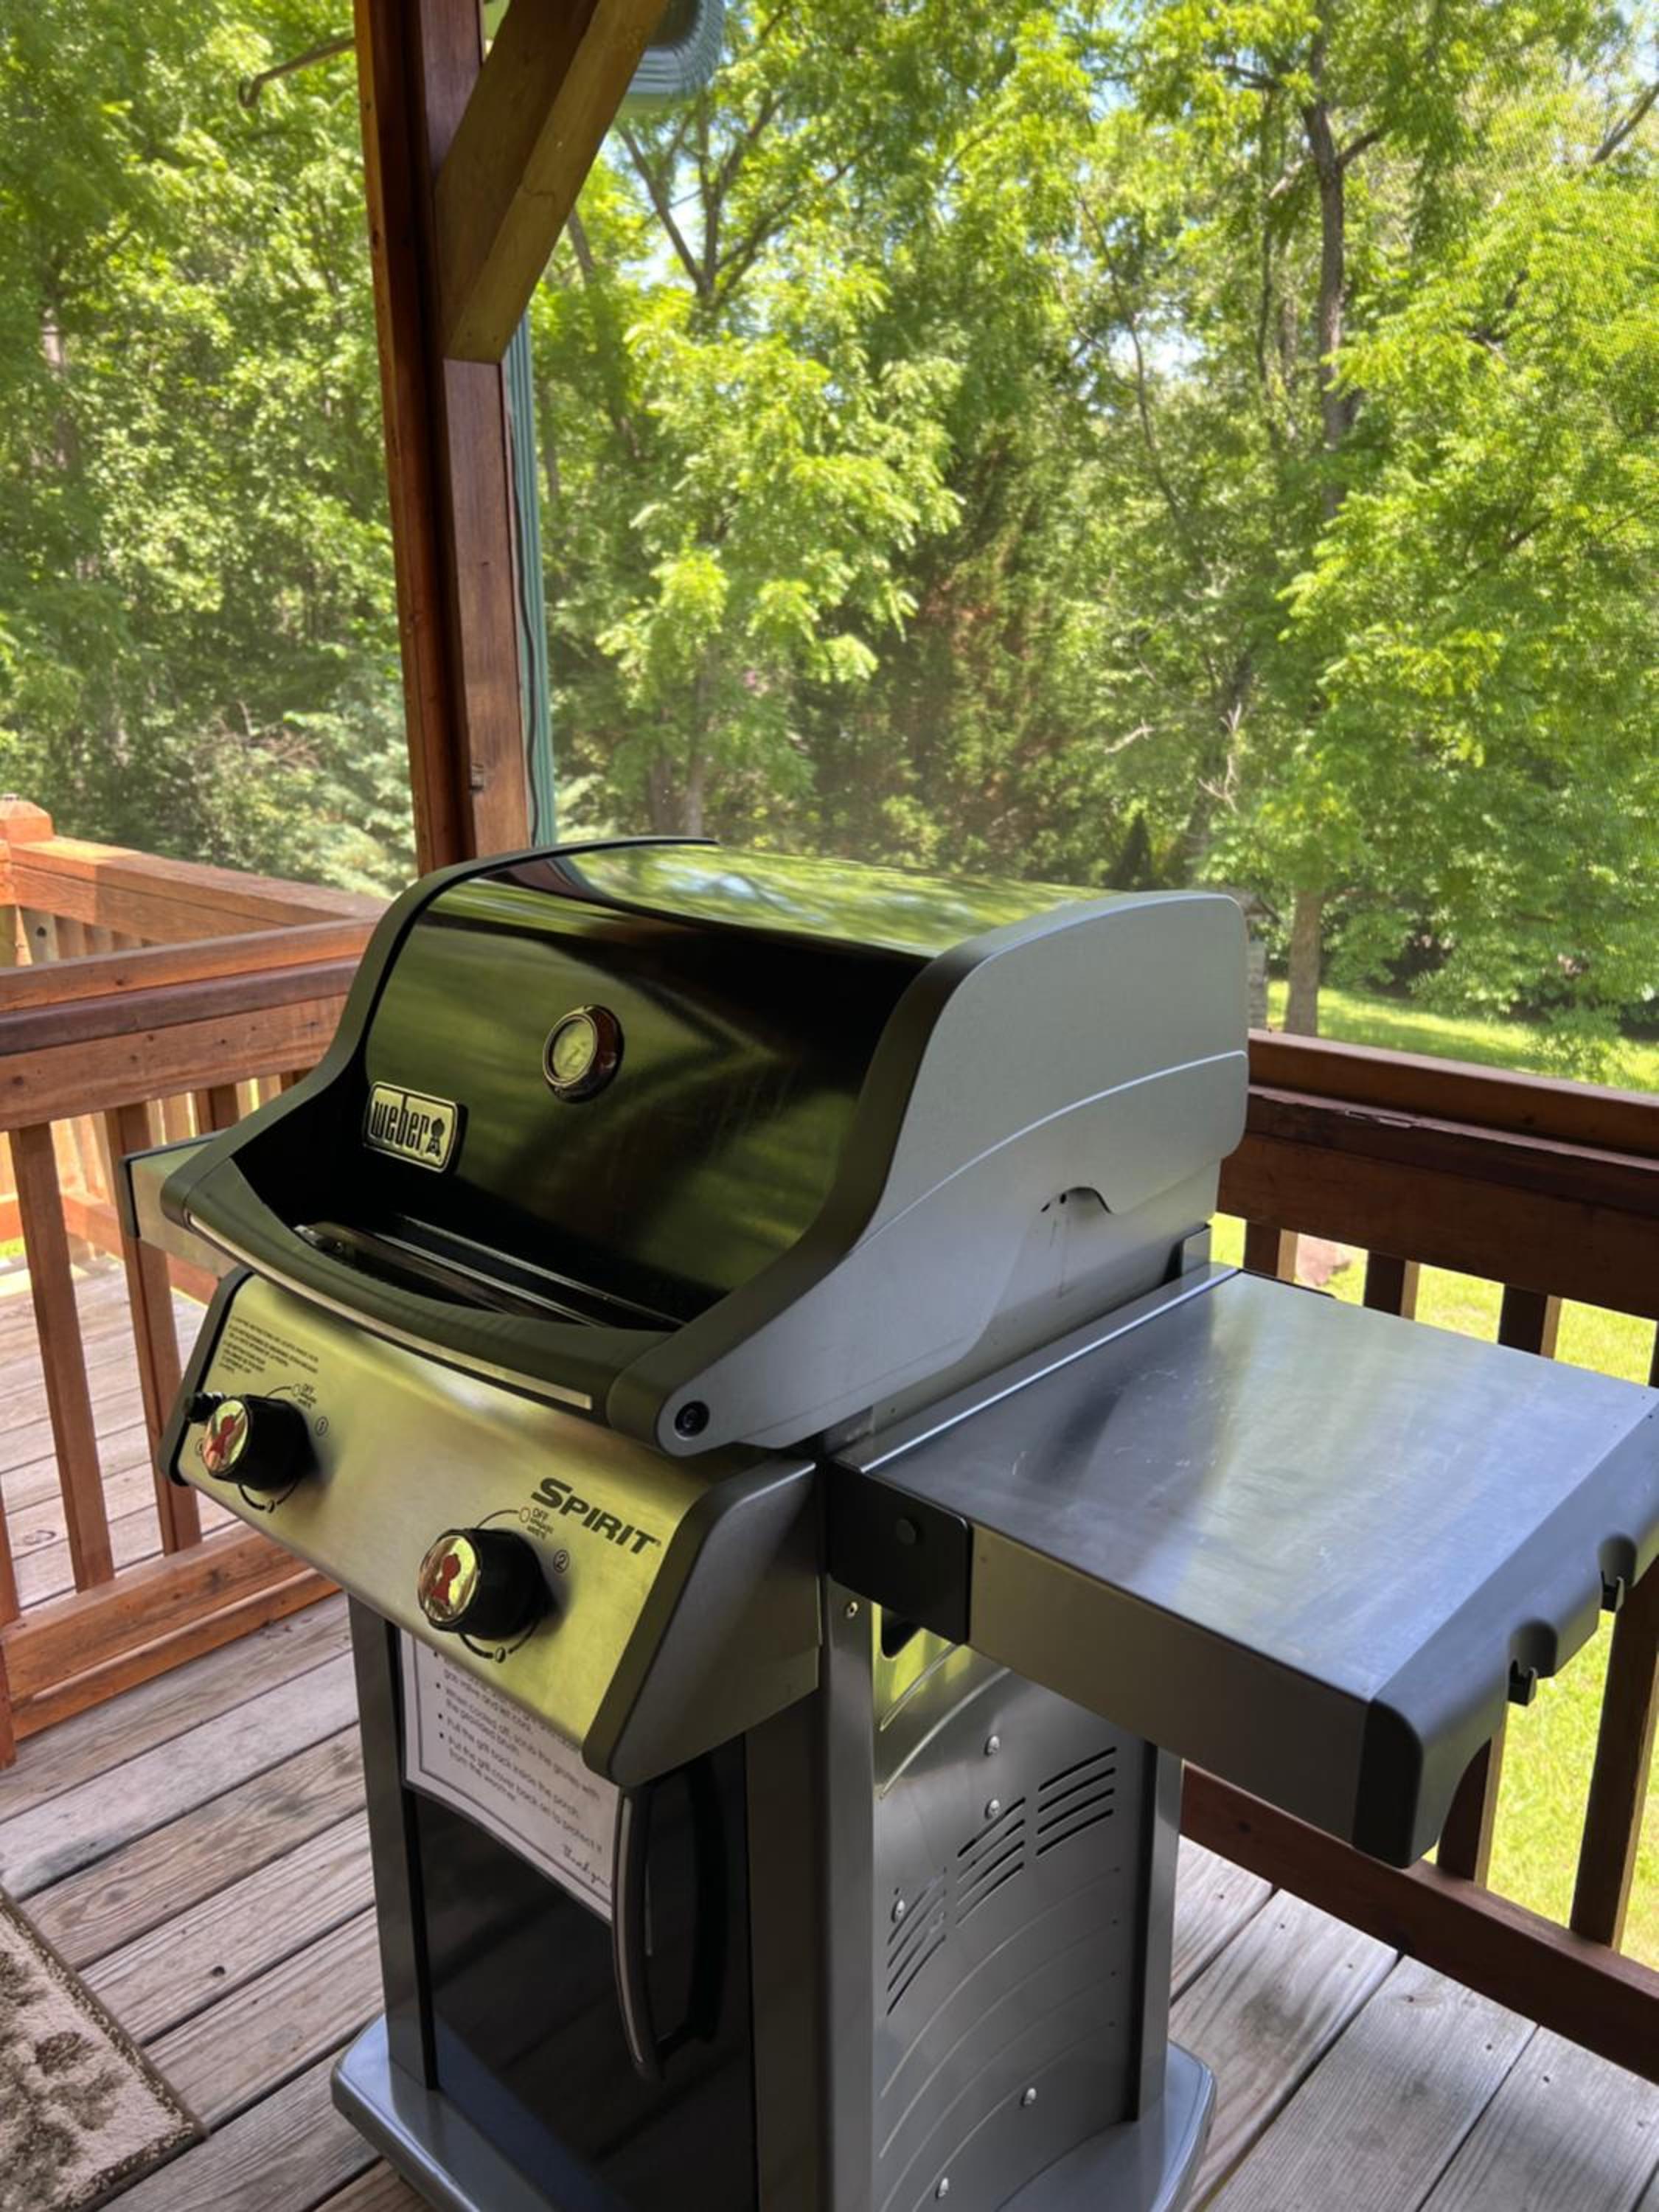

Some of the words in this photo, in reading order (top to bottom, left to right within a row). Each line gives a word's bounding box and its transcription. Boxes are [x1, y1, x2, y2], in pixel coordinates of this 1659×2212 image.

[372, 1094, 430, 1151] weber
[531, 1477, 658, 1554] SPIRIT
[462, 1728, 475, 1742] the
[538, 1781, 552, 1798] the
[463, 1746, 476, 1761] the
[470, 1761, 482, 1778] the
